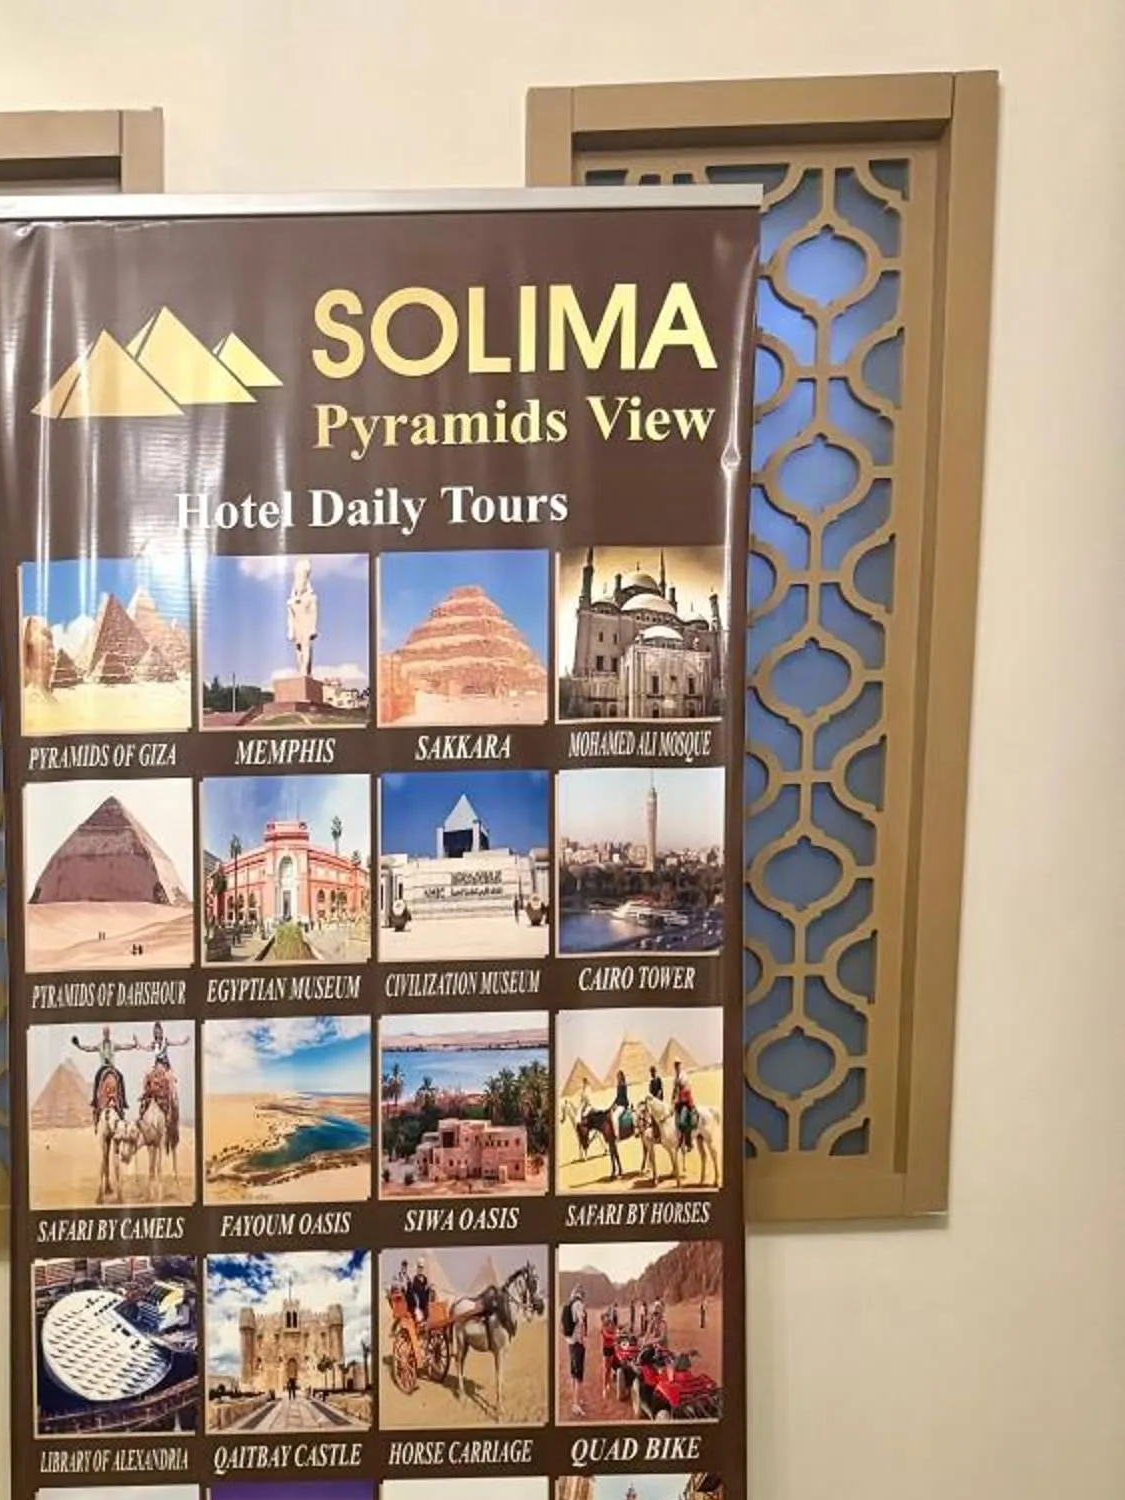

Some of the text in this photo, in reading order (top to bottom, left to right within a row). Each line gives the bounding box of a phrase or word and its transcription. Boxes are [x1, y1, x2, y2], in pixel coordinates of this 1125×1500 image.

[311, 282, 719, 381] SOLIMA
[312, 395, 717, 461] Pyramids View
[176, 484, 569, 536] Hotel Daily Tours
[29, 742, 177, 770] PYRAMIDS OF GIZA
[235, 738, 336, 766] MEMPHIS
[415, 734, 512, 761] SAKKARA
[568, 730, 712, 762] MOHAMED ALI MOSQUE
[207, 975, 361, 1003] EGYPTIAN MUSEUM
[385, 970, 540, 997] CIVILIZATION MUSEUM
[579, 966, 695, 991] CAIRO TOWER
[32, 980, 186, 1008] PYRAMIDS OF DAHSHOUR
[220, 1212, 352, 1238] FAYOUM OASIS
[404, 1207, 519, 1232] SIWA OASIS
[566, 1201, 711, 1227] SAFARI BY HORSES
[37, 1216, 185, 1243] SAFARI BY CAMELS
[40, 1448, 188, 1473] LIBRARY OF ALEXANDRIA
[214, 1443, 363, 1475] QAITBAY CASTLE
[388, 1439, 534, 1465] HORSE CARRIAGE
[571, 1436, 702, 1467] QUAD BIKE
